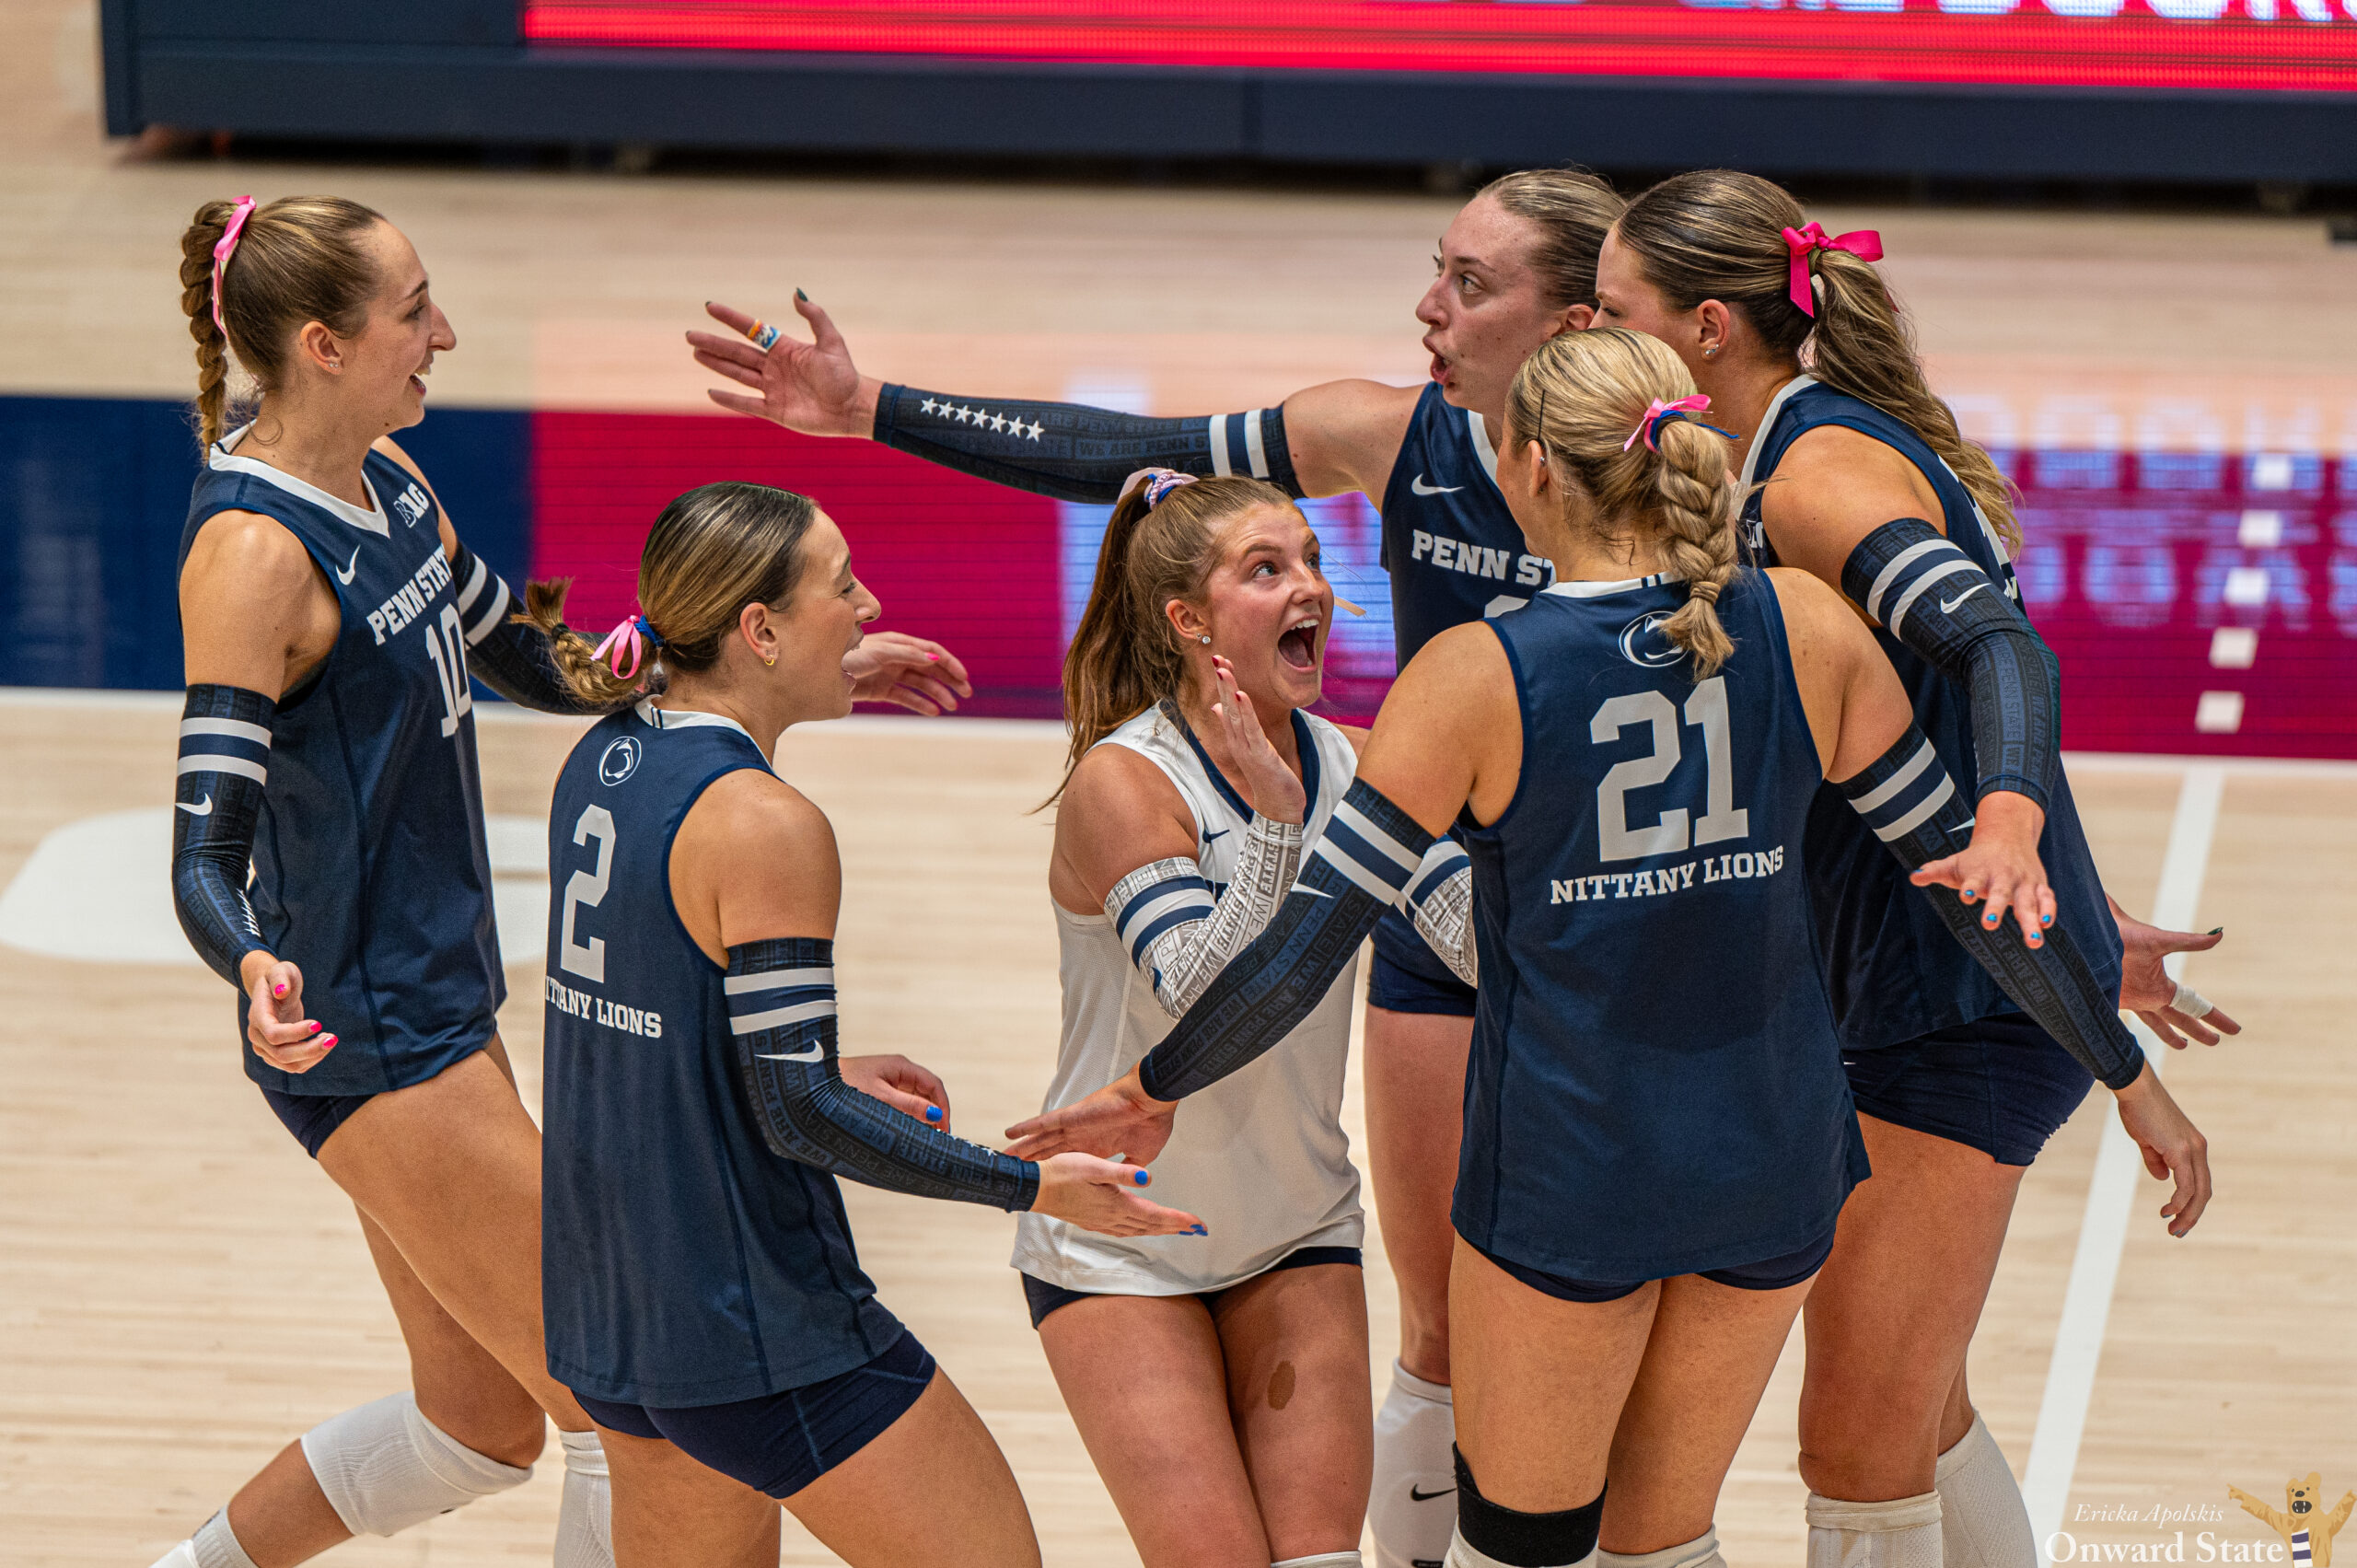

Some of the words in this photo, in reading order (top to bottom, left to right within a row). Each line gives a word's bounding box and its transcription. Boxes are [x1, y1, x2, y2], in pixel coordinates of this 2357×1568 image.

[1411, 528, 1510, 580] PENN
[366, 577, 428, 646] PENN
[425, 602, 472, 738] 10
[1590, 676, 1749, 863] 21
[561, 804, 617, 984] 2
[1550, 862, 1696, 905] NITTANY
[1703, 845, 1784, 884] LIONS
[1249, 902, 1268, 931] WE
[1287, 905, 1325, 955] PENN
[1196, 955, 1222, 984] WE
[545, 975, 591, 1020] ITTANY
[597, 997, 662, 1039] LIONS
